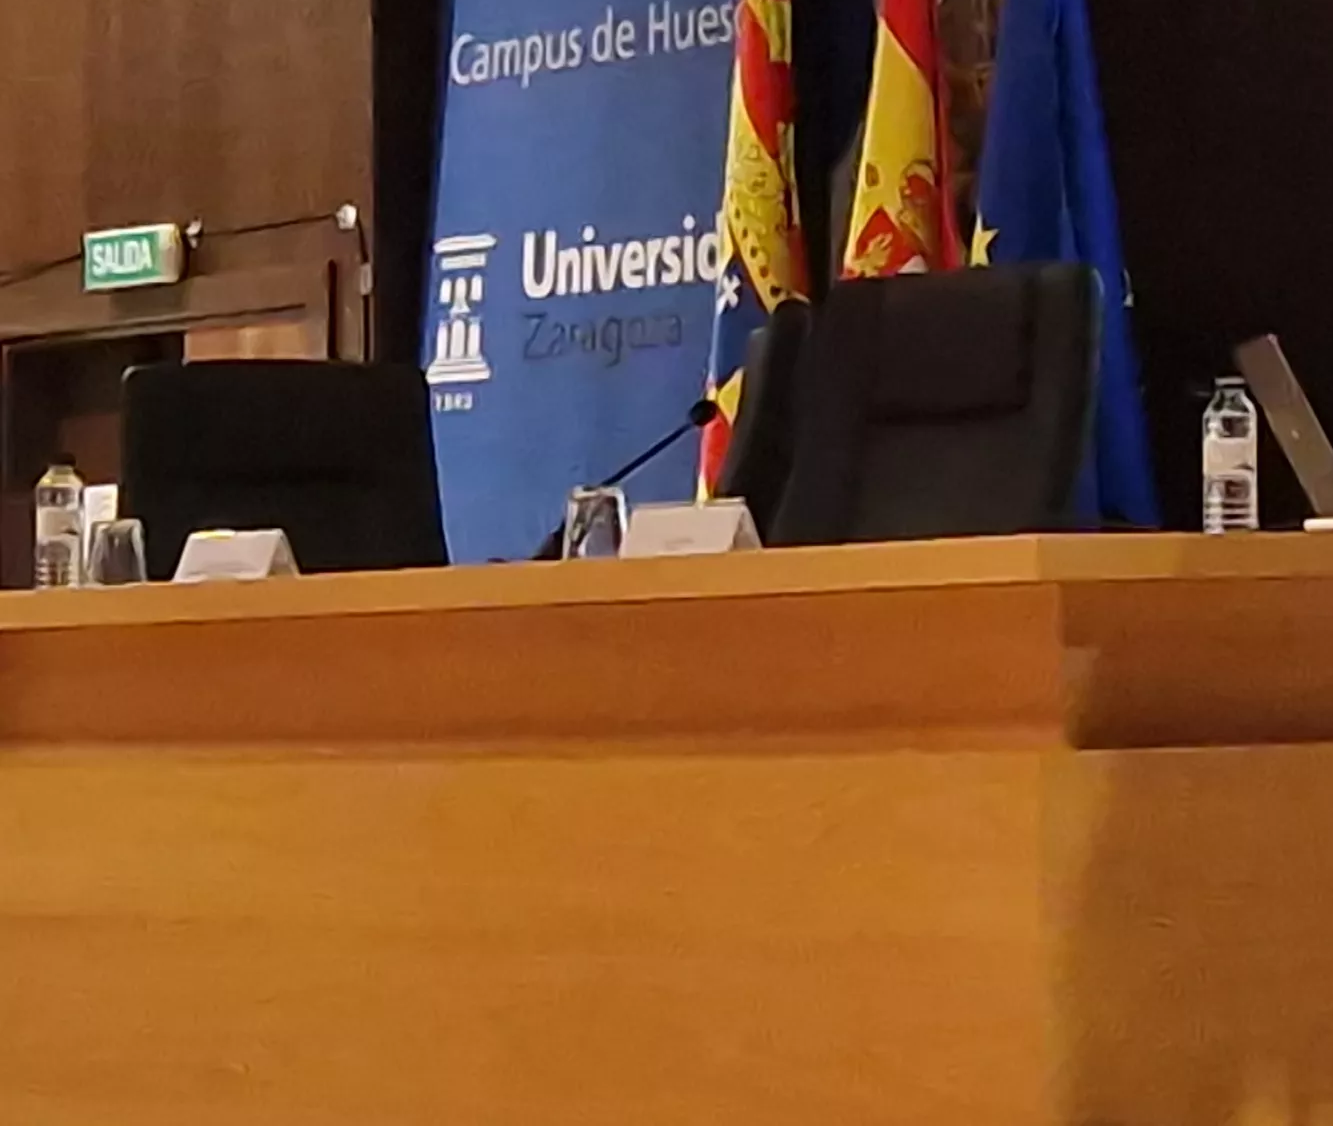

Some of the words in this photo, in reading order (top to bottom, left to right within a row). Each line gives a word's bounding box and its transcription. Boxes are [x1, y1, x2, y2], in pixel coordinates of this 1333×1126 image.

[449, 26, 582, 88] Campus
[591, 6, 636, 63] de
[92, 237, 152, 277] SALIDA
[522, 212, 722, 300] Universid
[523, 311, 685, 367] Zaragoza
